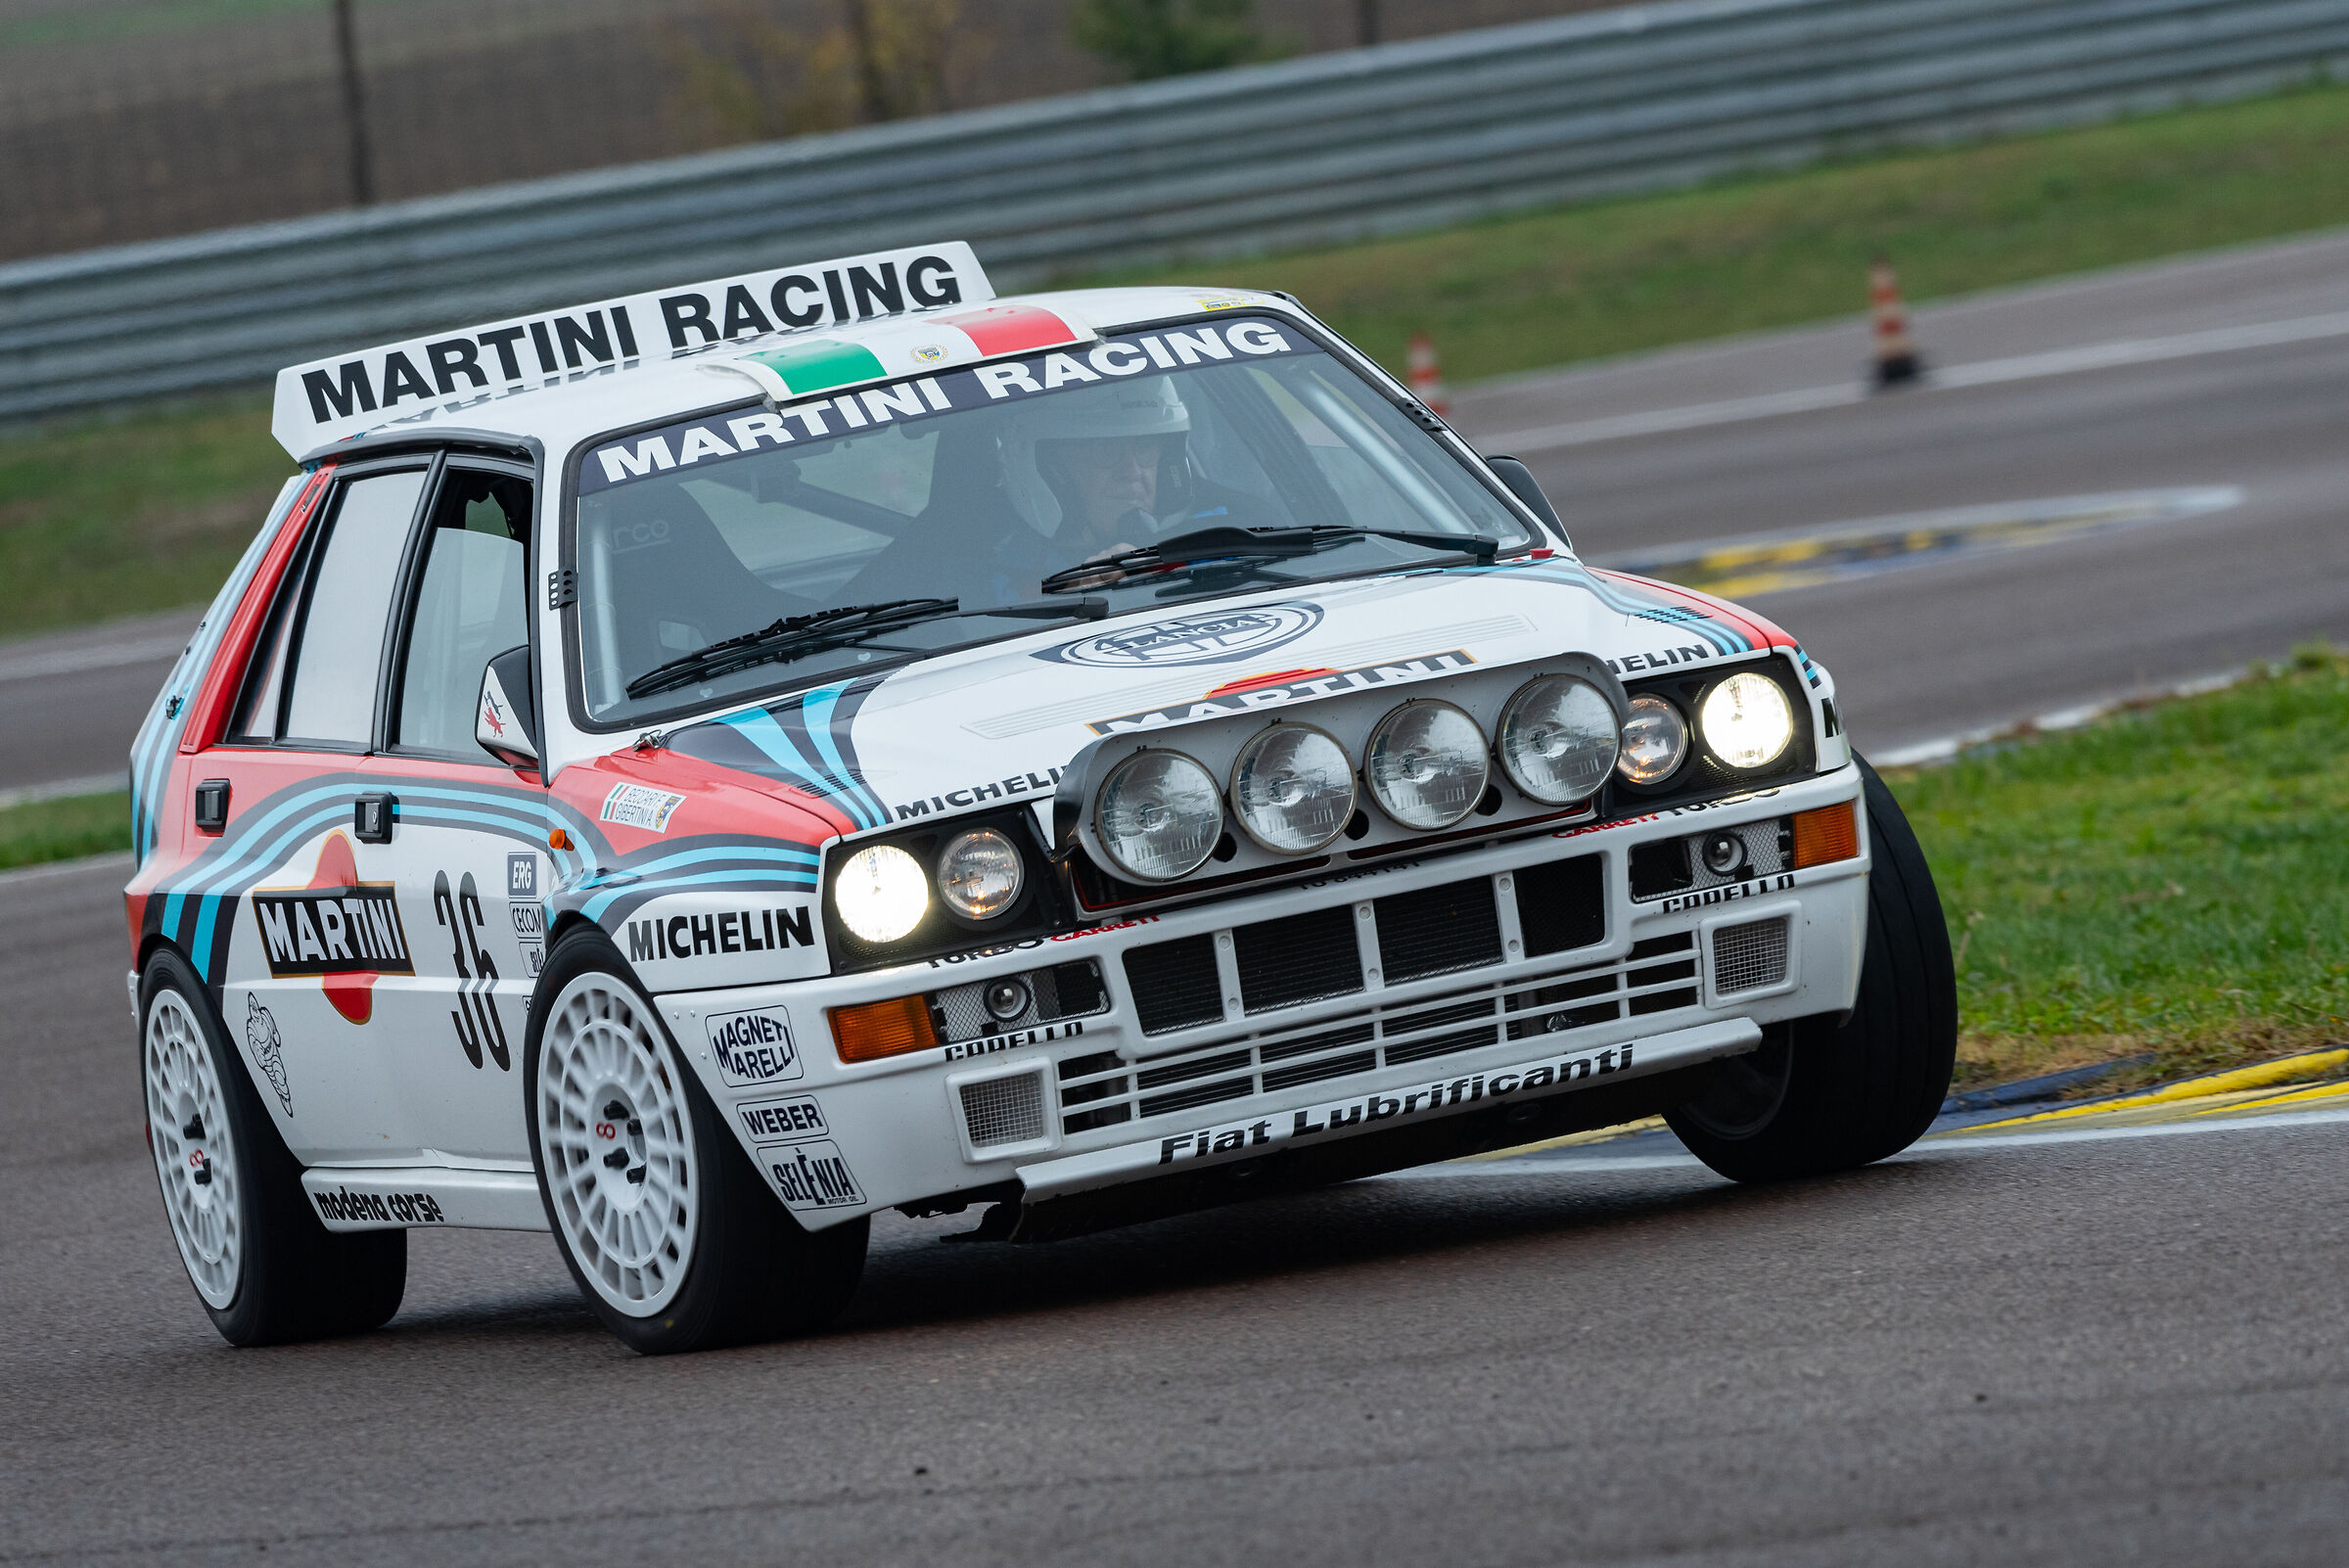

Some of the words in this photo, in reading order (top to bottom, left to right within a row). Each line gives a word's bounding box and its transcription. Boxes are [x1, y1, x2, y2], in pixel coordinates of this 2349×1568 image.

[301, 306, 640, 424] MARTINI
[659, 255, 963, 349] RACING
[596, 377, 953, 484] MARTINI
[973, 322, 1292, 399] RACING
[1605, 644, 1710, 675] HELIN
[1107, 655, 1465, 732] MARTINI
[895, 765, 1069, 821] MICHELI
[1551, 813, 1660, 839] GARRETT
[512, 860, 531, 889] ERG
[258, 899, 406, 962] MARTINI
[512, 908, 541, 933] CECOM
[627, 905, 815, 962] MICHELIN
[1050, 915, 1161, 942] GARRETT
[434, 869, 511, 1072] 36
[714, 1015, 795, 1056] MAGNETI
[742, 1103, 824, 1135] WEBER
[1158, 1119, 1271, 1166] Fiat
[1290, 1043, 1635, 1138] Lubrificanti
[313, 1185, 392, 1222] modena
[387, 1193, 444, 1222] corse
